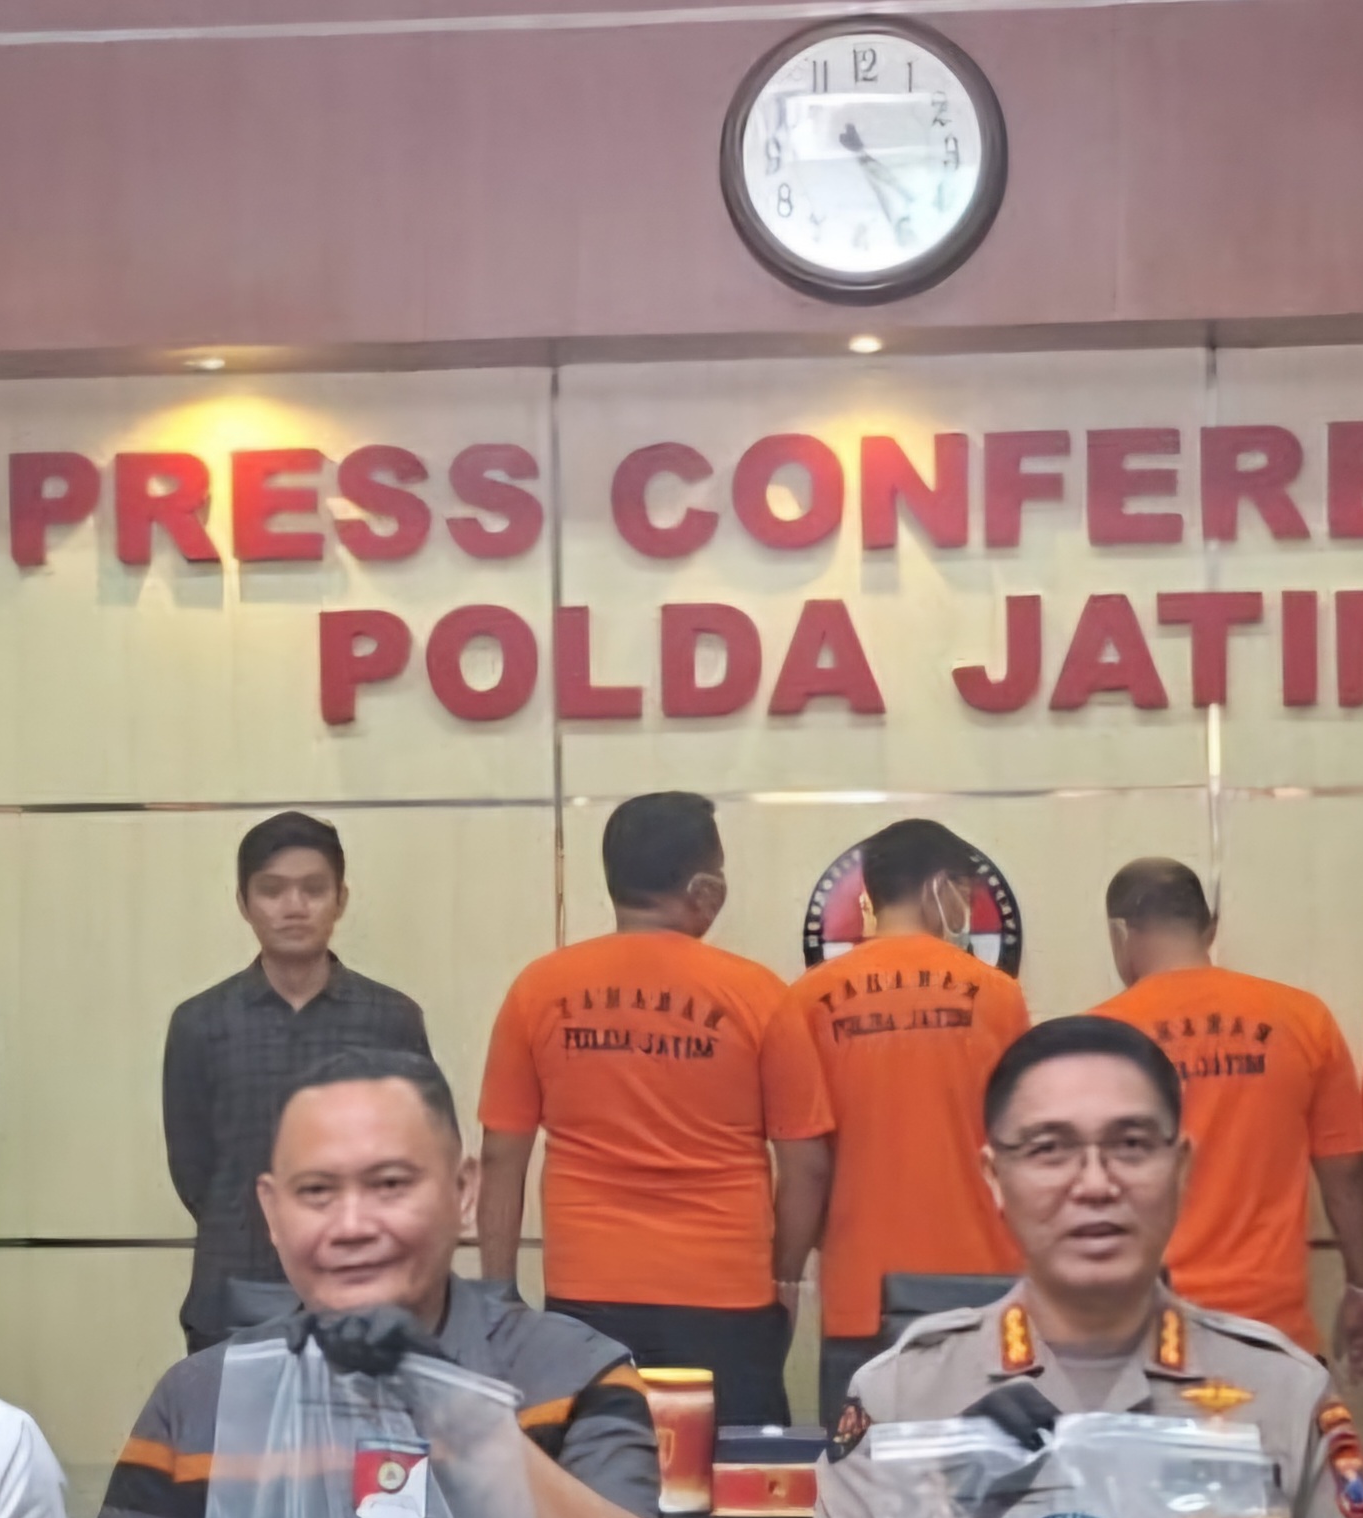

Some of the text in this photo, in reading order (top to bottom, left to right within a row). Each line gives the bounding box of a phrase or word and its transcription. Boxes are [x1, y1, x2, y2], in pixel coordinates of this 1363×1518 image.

[811, 60, 829, 93] 11
[852, 47, 879, 84] 12
[930, 91, 952, 127] 2
[776, 182, 793, 218] 8
[8, 442, 545, 567] PRESS
[318, 599, 887, 727] POLDA
